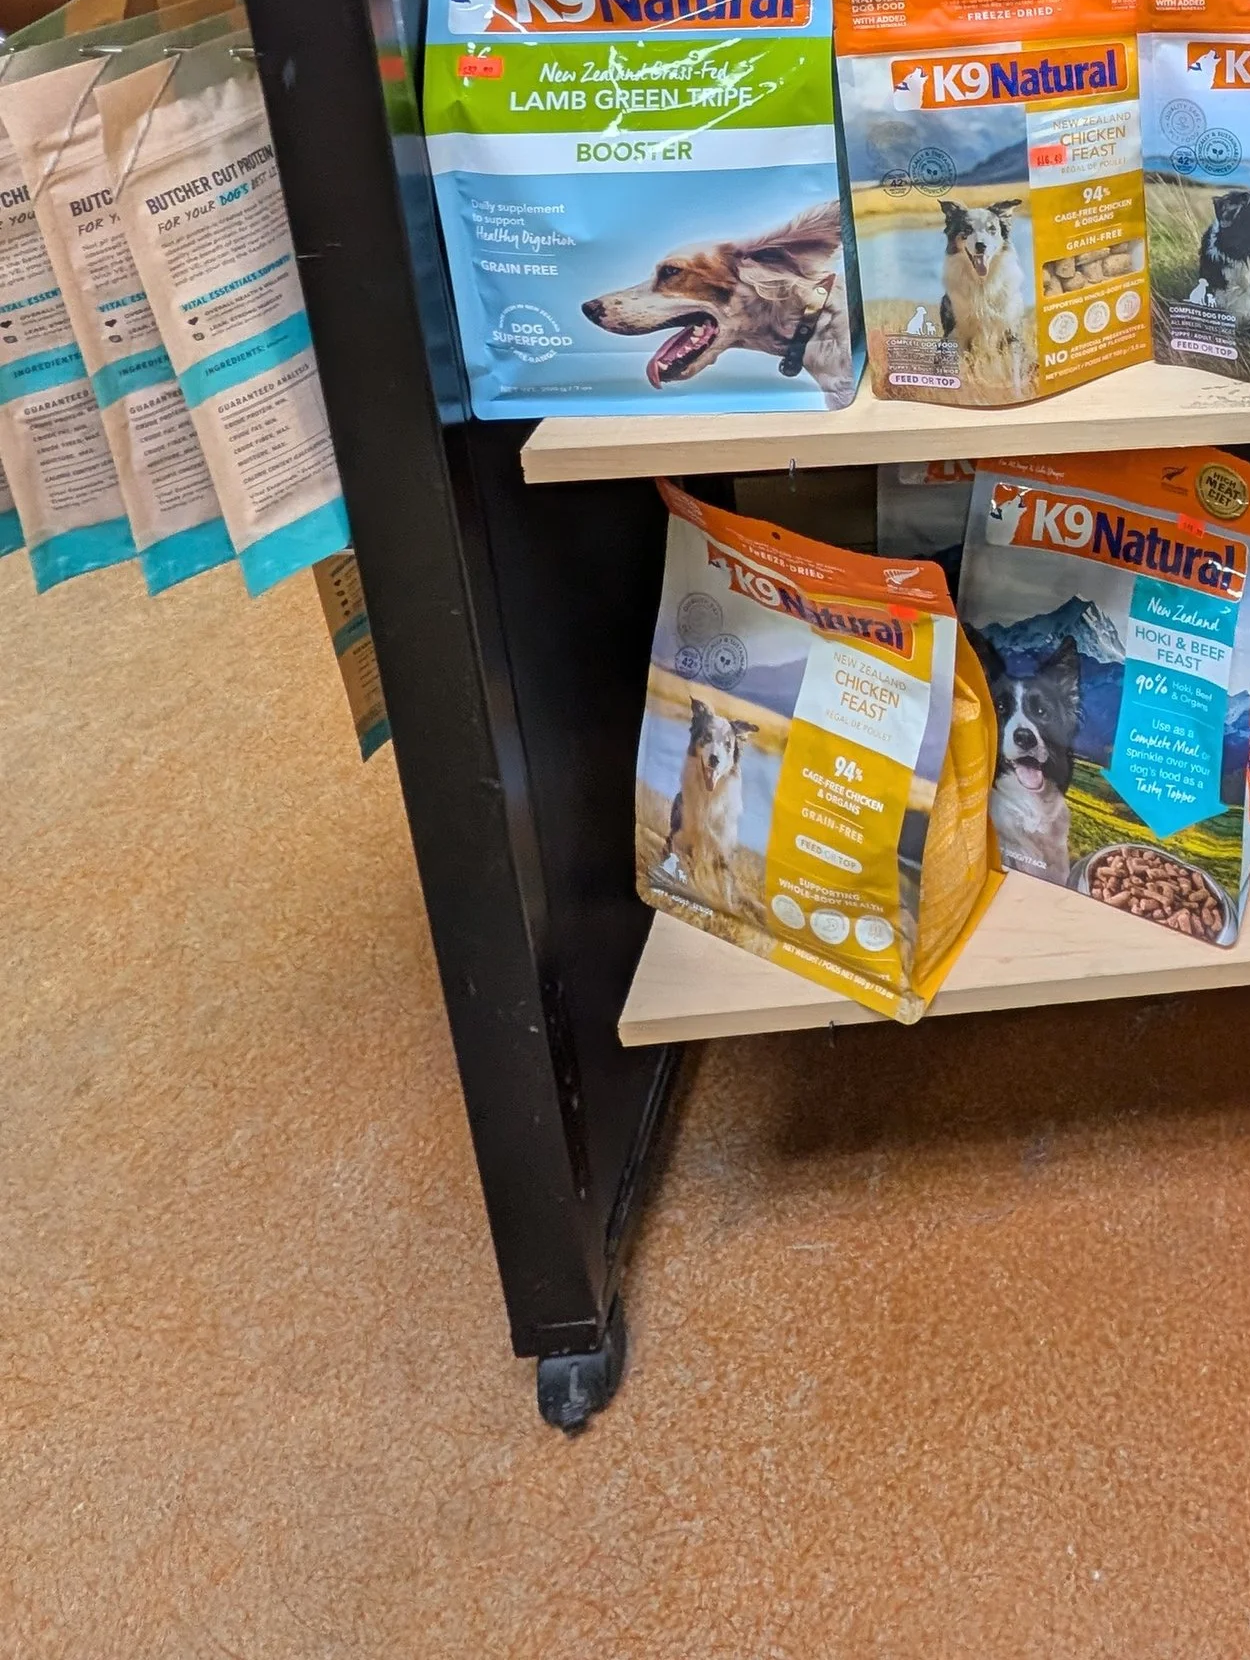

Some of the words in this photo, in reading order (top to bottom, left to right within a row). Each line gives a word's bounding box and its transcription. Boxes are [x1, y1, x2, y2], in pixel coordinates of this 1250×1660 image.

[509, 90, 586, 111] LAMB
[594, 88, 679, 111] GREEN
[684, 85, 753, 108] TRIPE
[1059, 126, 1126, 147] CHICKEN
[576, 141, 692, 162] BOOSTER
[1071, 142, 1117, 162] FEAST
[146, 177, 212, 214] BUTCHER
[212, 164, 237, 186] CUT
[240, 144, 275, 175] PROTEIN
[157, 216, 181, 234] FOR
[185, 200, 216, 222] YOUR
[219, 182, 250, 206] DOG'S
[480, 260, 520, 275] GRAIN
[524, 263, 558, 275] FREE
[492, 331, 572, 347] SUPERFOOD
[511, 323, 544, 335] DOG
[1135, 625, 1172, 646] HOKI
[1176, 637, 1187, 650] &
[1190, 641, 1225, 660] BEEF
[1157, 648, 1202, 671] FEAST
